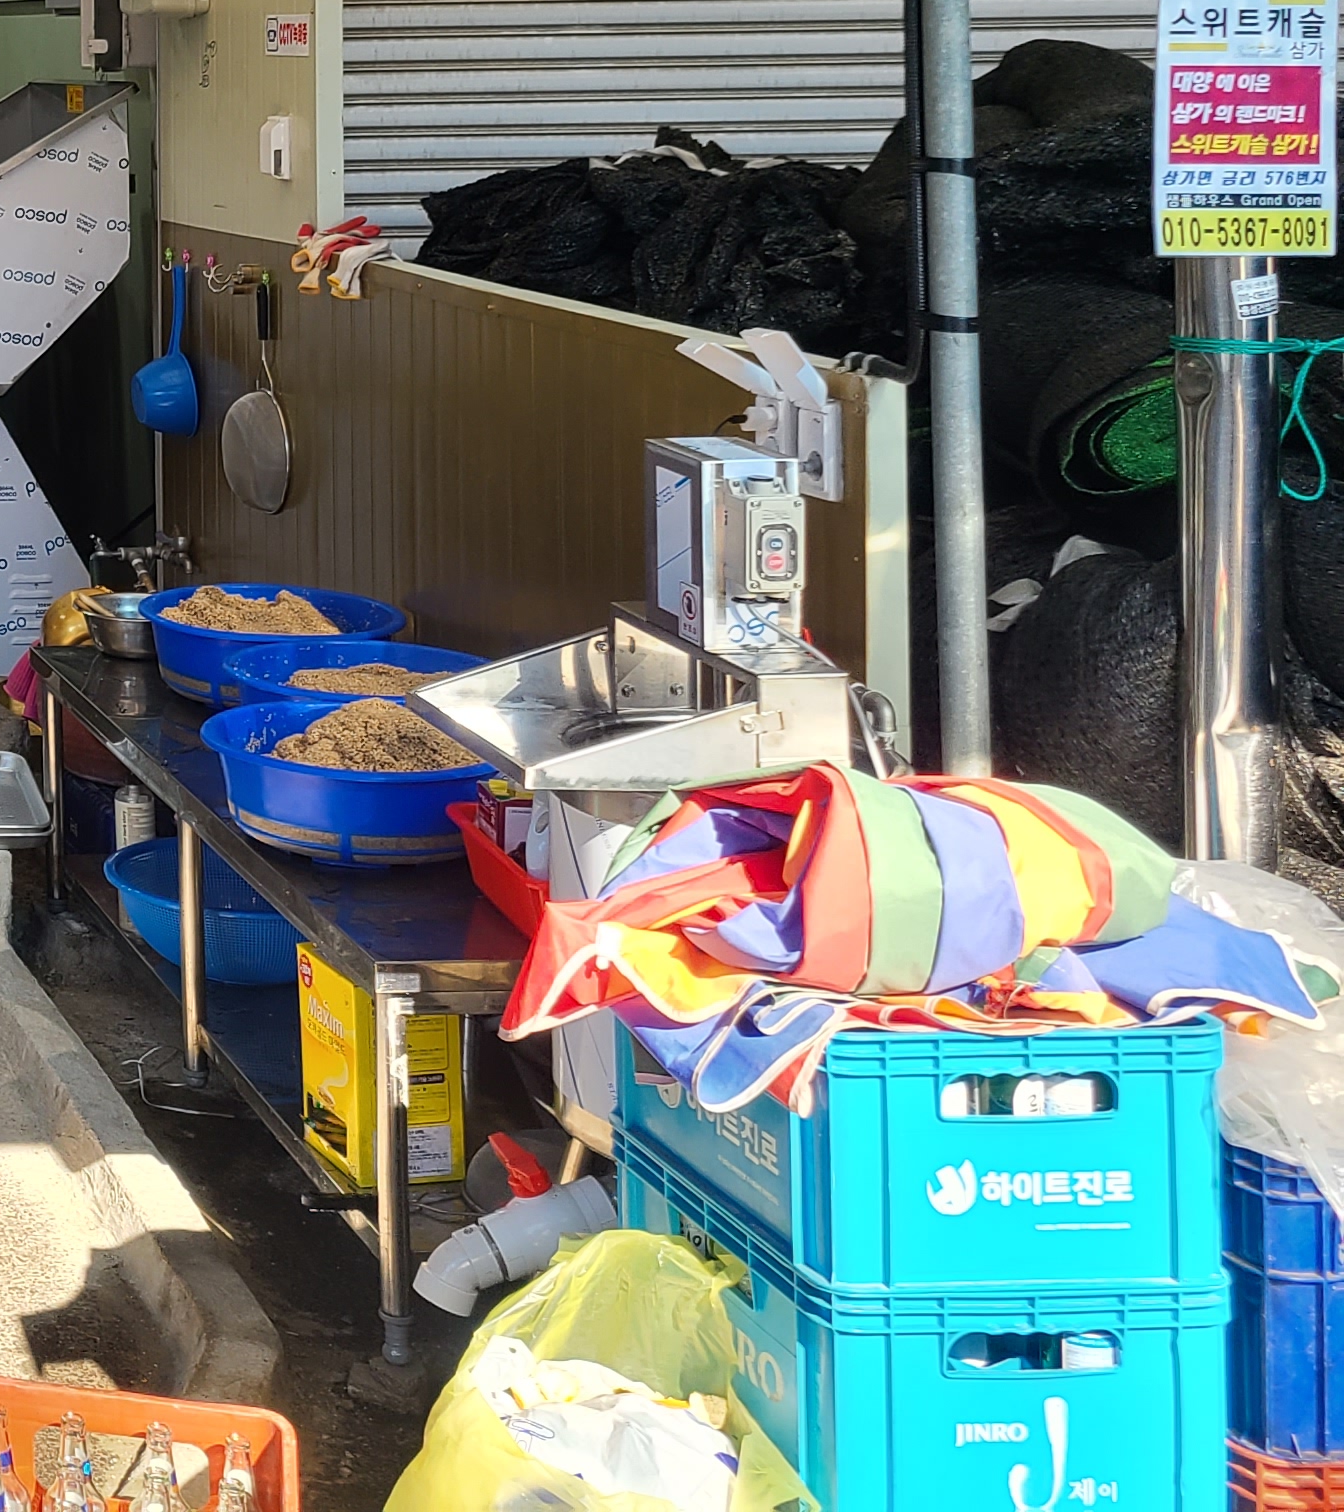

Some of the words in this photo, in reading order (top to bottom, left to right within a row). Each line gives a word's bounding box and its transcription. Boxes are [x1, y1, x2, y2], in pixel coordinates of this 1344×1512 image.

[1169, 7, 1327, 38] 스위트캐슬
[1289, 41, 1325, 61] 삼가
[1172, 71, 1215, 94] 대양
[1216, 74, 1234, 93] 에
[1237, 72, 1272, 94] 이은
[1171, 103, 1213, 126] 삼가
[1213, 104, 1232, 125] 의
[1235, 104, 1306, 125] 랜드마크!
[1170, 134, 1271, 156] 스위트캐슬
[1222, 170, 1256, 187] 금리
[1264, 170, 1327, 187] 576번지
[1240, 194, 1283, 208] Grand
[1288, 194, 1322, 209] Open
[15, 207, 68, 225] posco
[1161, 216, 1329, 248] 010-5367-8091
[3, 268, 56, 286] posco
[307, 994, 345, 1038] Maxim
[979, 1169, 1136, 1207] 하이트진로
[954, 1422, 1030, 1448] JINRO
[1007, 1395, 1070, 1512] J
[1067, 1476, 1119, 1507] 제이
